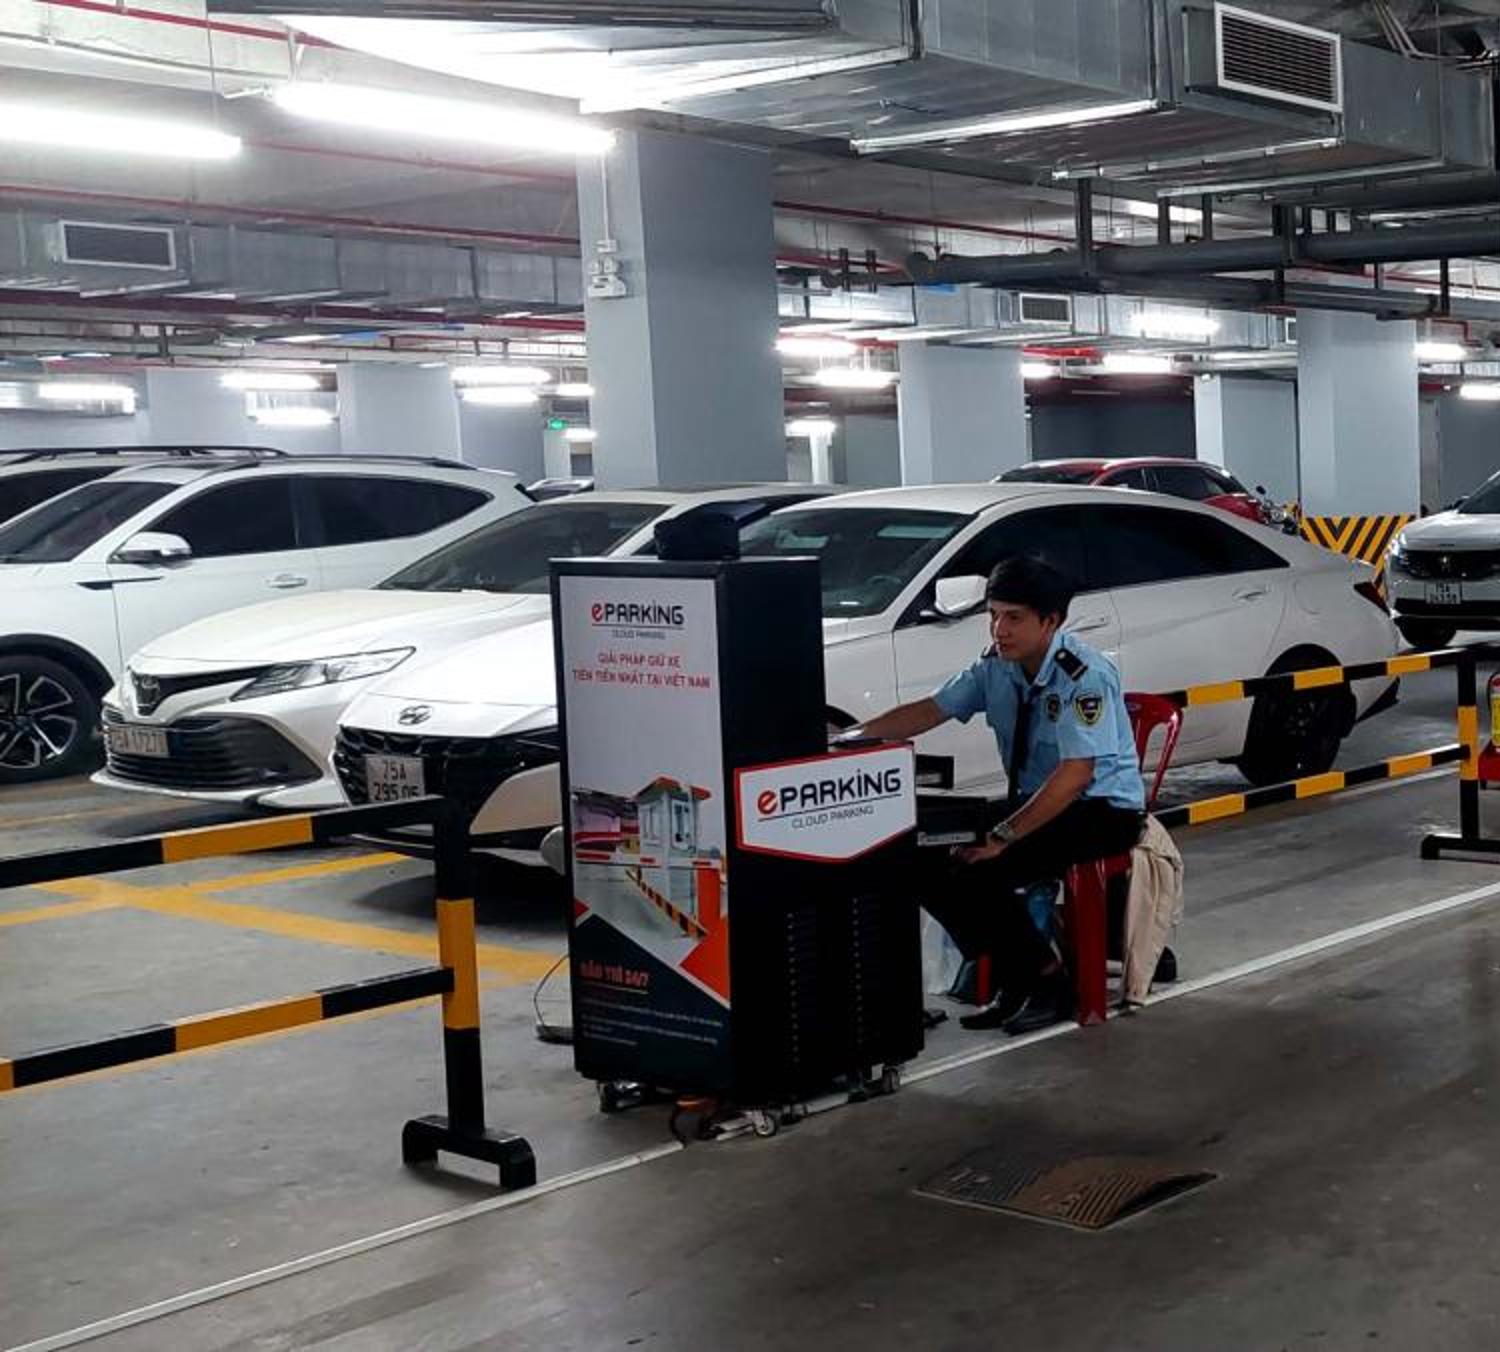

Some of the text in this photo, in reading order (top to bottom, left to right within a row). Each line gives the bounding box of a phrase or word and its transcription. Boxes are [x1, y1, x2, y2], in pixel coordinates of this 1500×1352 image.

[591, 600, 685, 625] ePARKING
[383, 760, 406, 780] 75A
[757, 768, 901, 815] ePARKING
[791, 805, 874, 829] CLOUD PARKING
